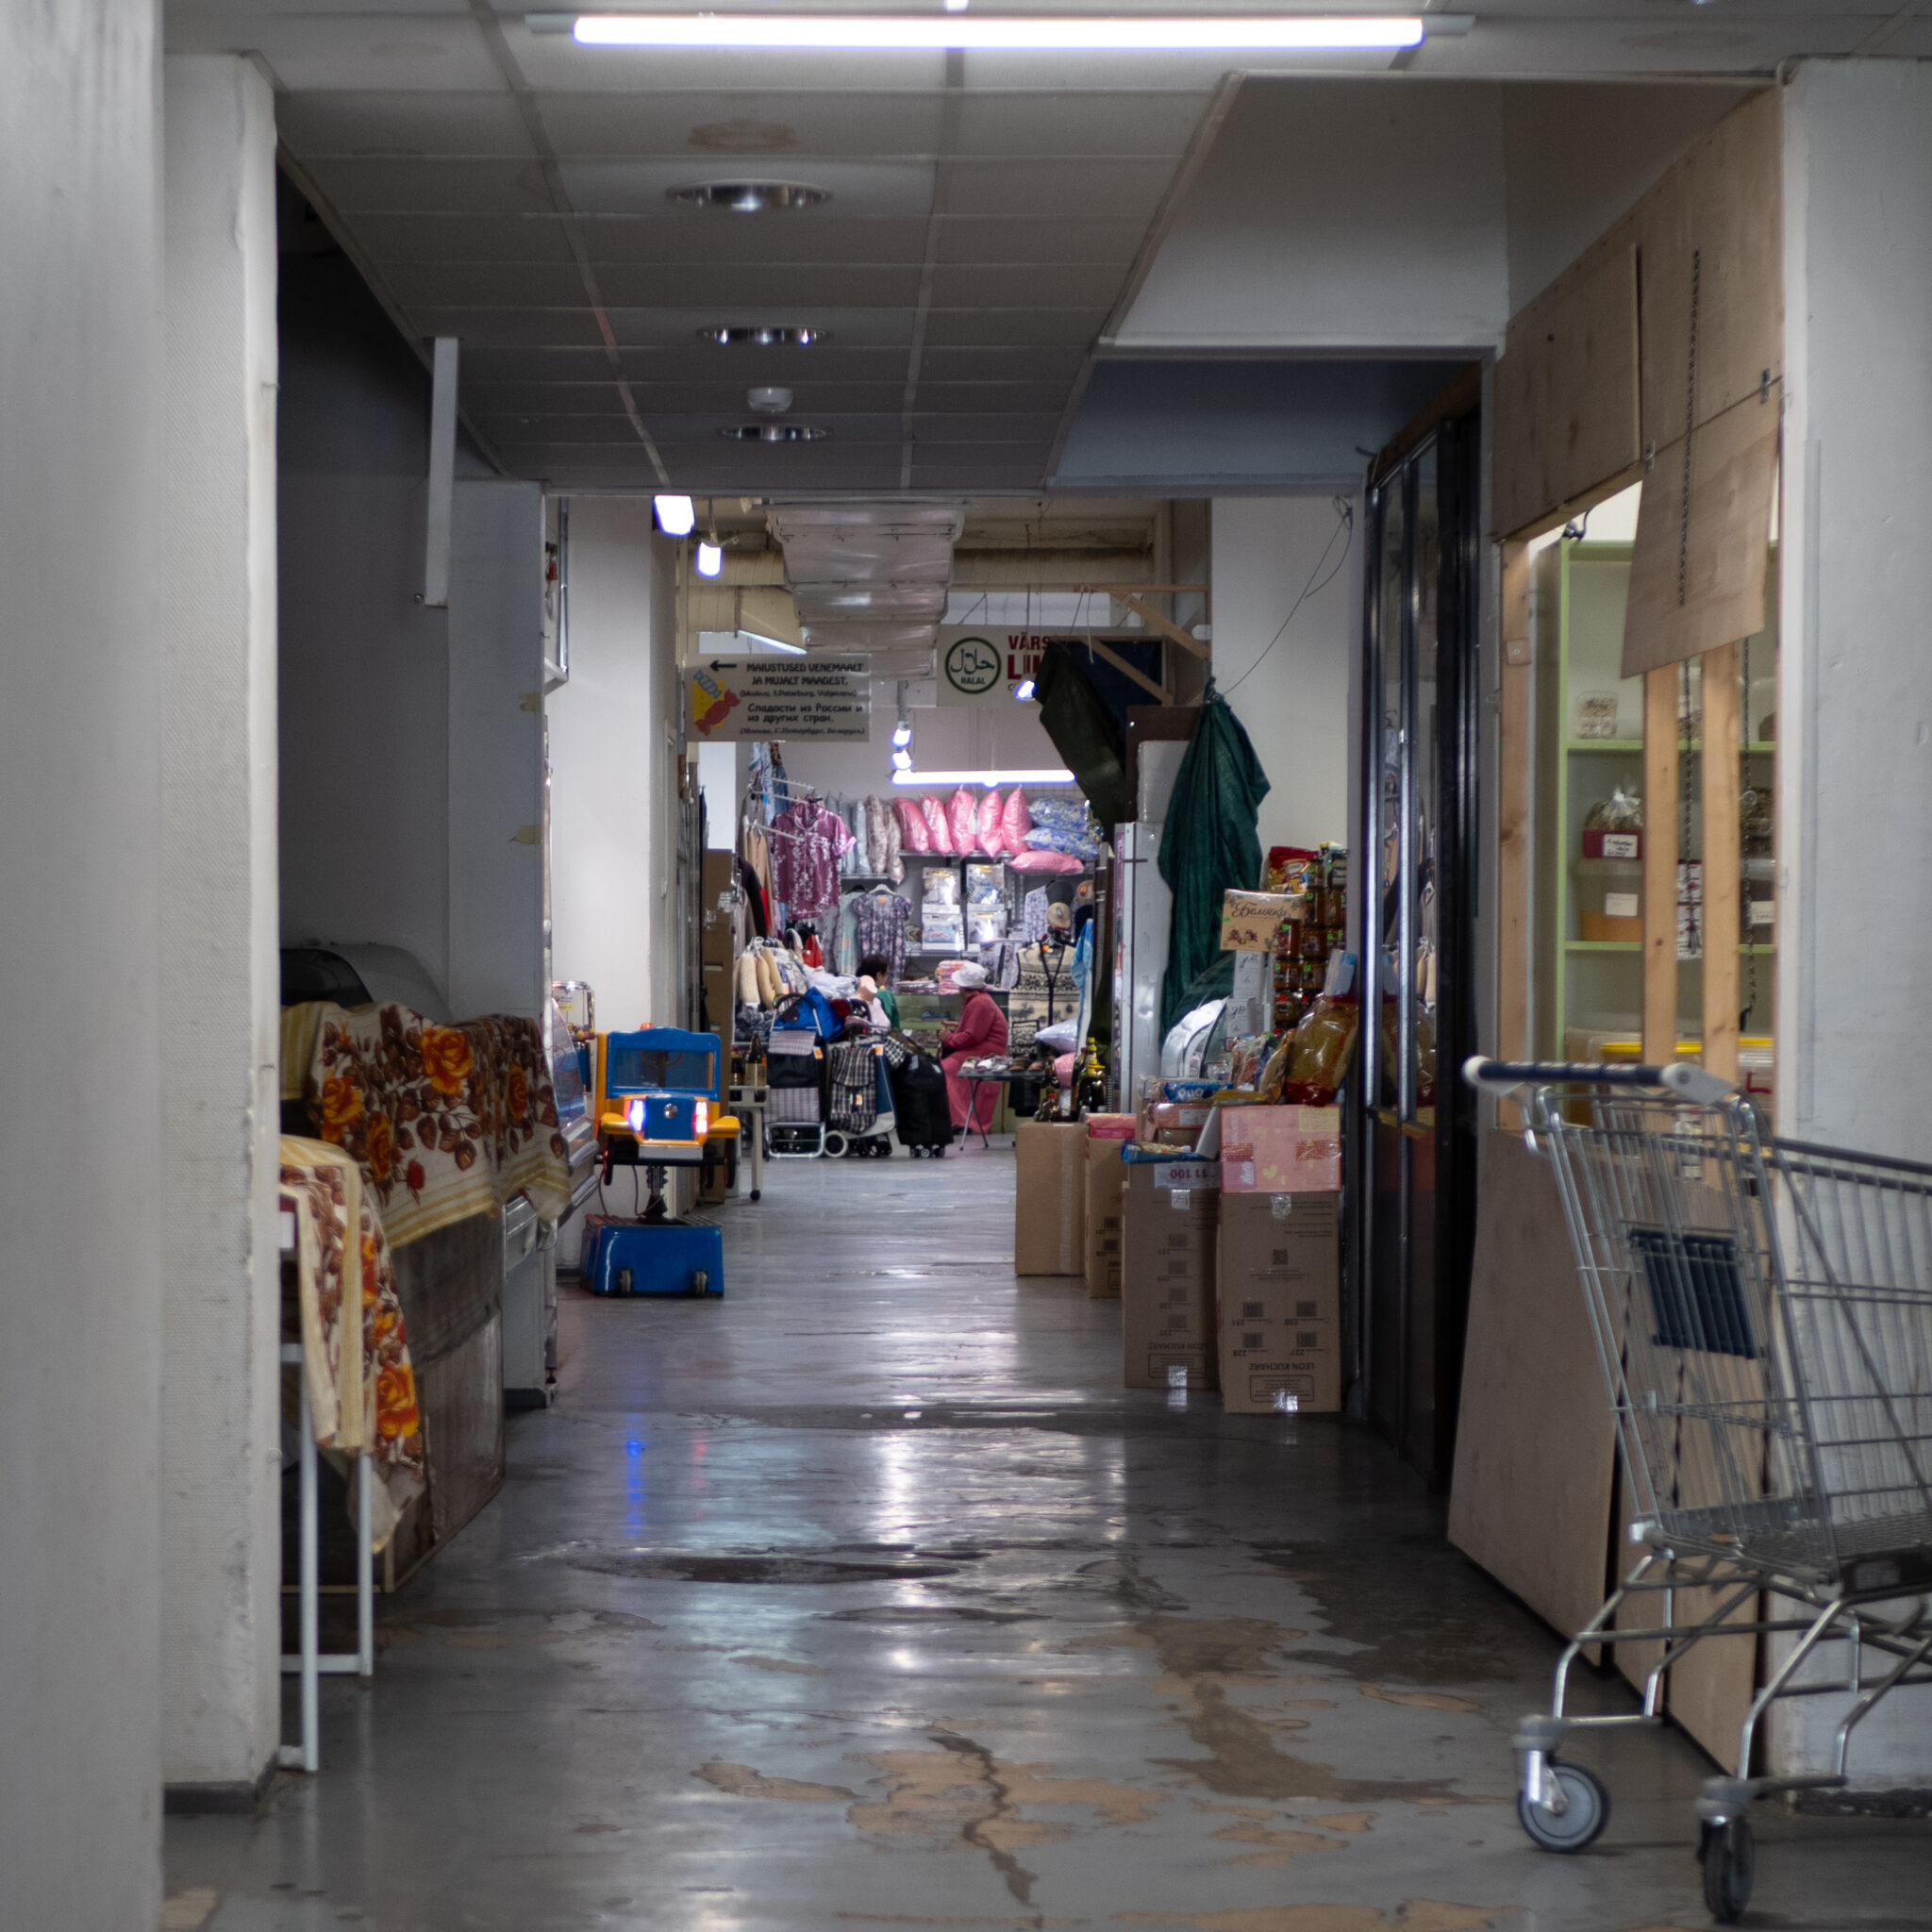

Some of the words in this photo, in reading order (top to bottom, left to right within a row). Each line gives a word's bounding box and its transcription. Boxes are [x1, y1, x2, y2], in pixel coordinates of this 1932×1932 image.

[1008, 632, 1051, 650] VÄRS
[746, 663, 807, 673] MAIUSTUSED
[808, 663, 863, 672] VENEMAALT
[752, 676, 763, 686] JA
[765, 676, 799, 686] MUJALT
[747, 704, 796, 713] Сладости
[800, 705, 812, 713] из
[816, 703, 852, 713] России
[763, 715, 799, 724] других
[1170, 1169, 1191, 1178] 100
[1248, 1362, 1290, 1371] KUCHARZ
